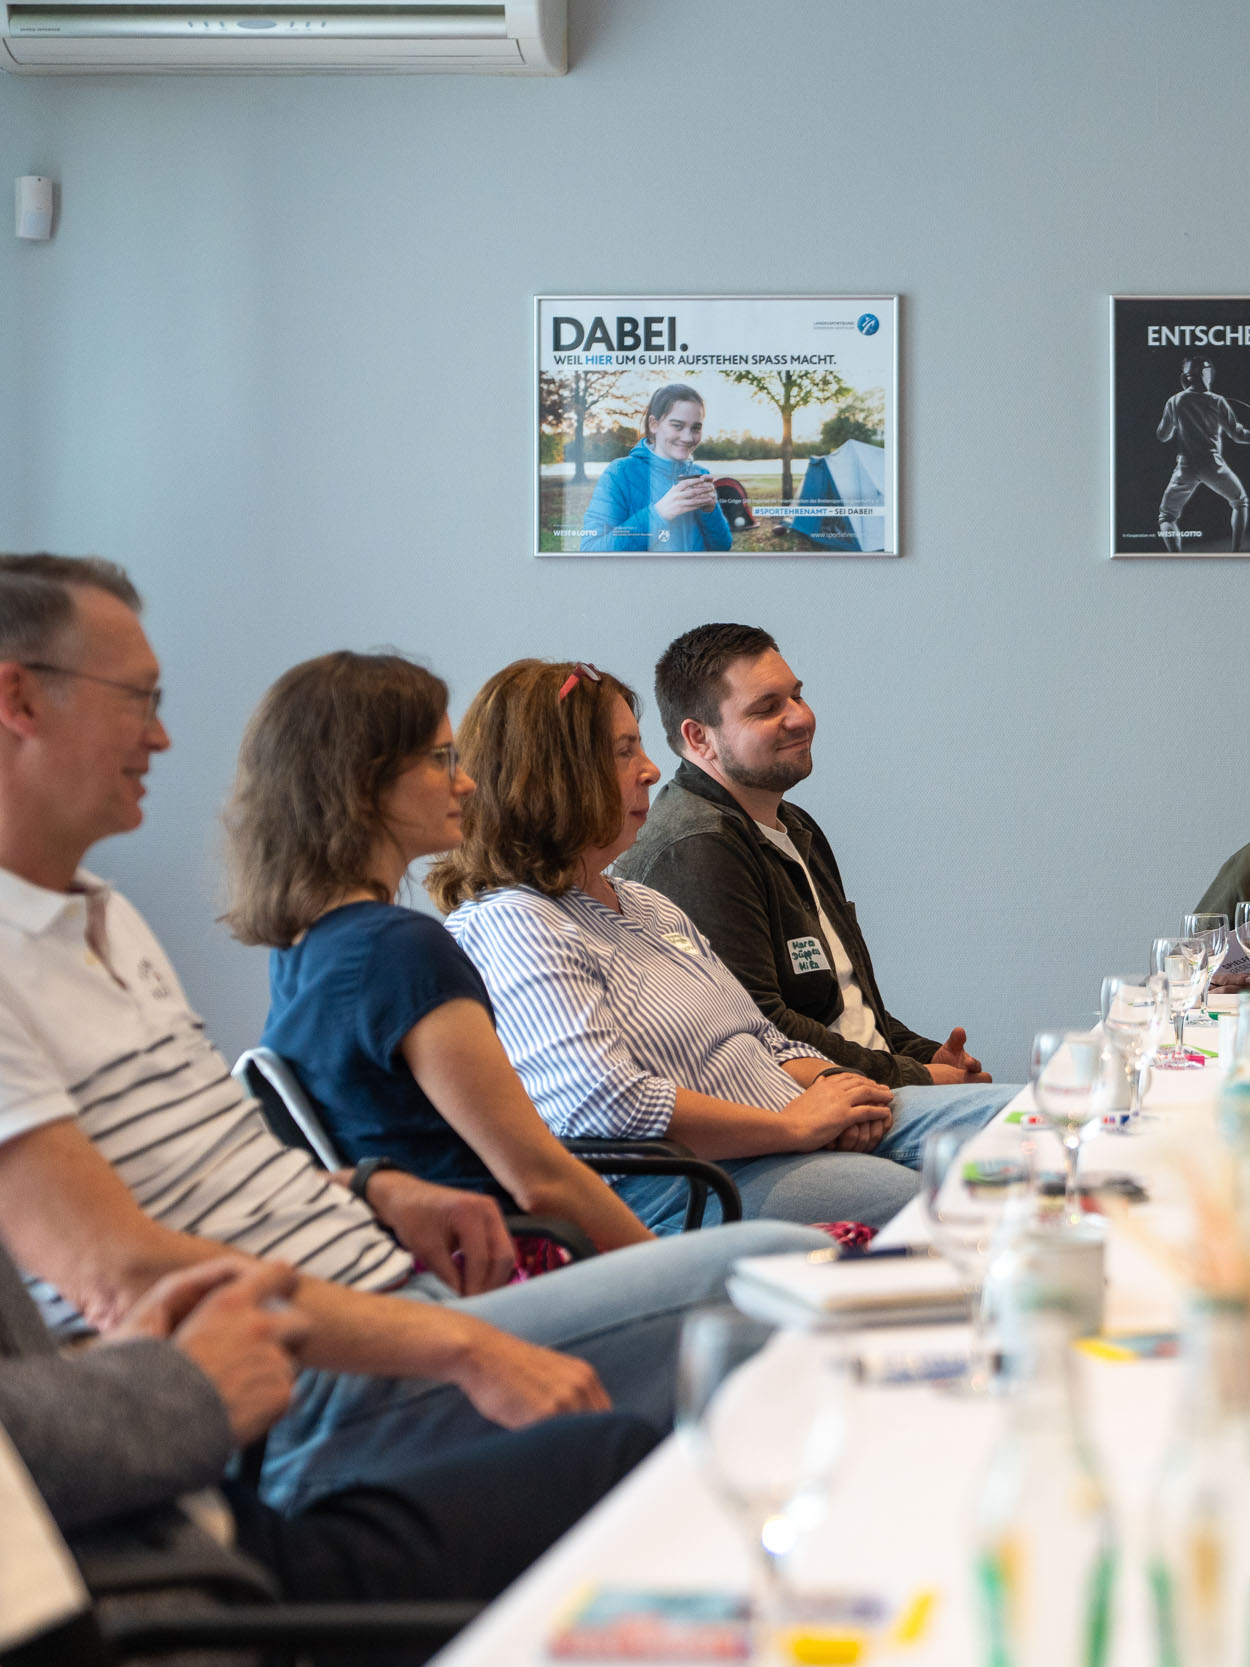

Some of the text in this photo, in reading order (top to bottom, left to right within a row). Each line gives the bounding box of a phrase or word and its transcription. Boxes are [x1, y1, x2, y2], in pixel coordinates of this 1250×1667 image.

[552, 316, 689, 352] DABEI.
[553, 354, 837, 365] WEIL HIER UM 6 UHR AUFSTEHEN SPASS MACHT.
